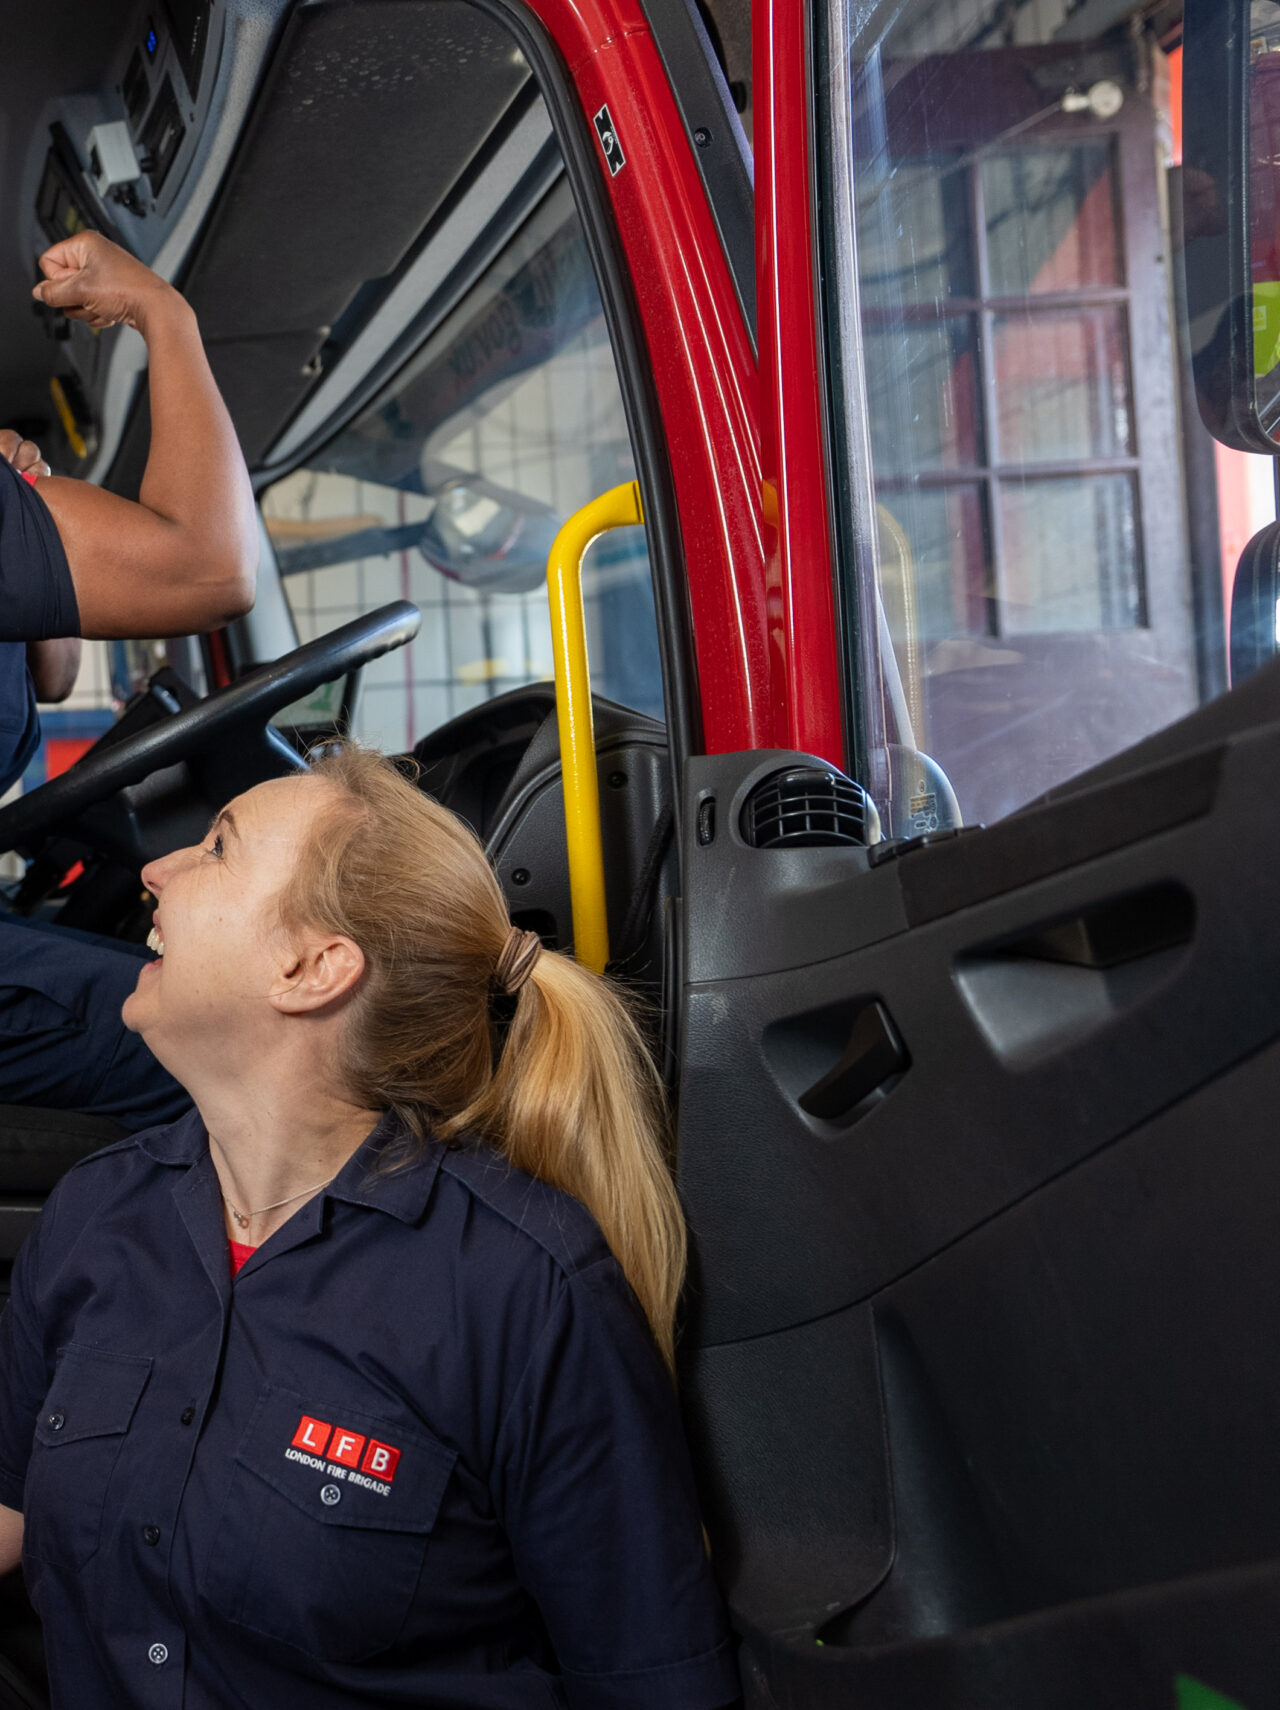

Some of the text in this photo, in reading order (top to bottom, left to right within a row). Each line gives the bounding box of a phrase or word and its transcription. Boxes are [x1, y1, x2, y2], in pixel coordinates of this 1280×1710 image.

[285, 1448, 392, 1497] LONDON FIRE BRIGADE
